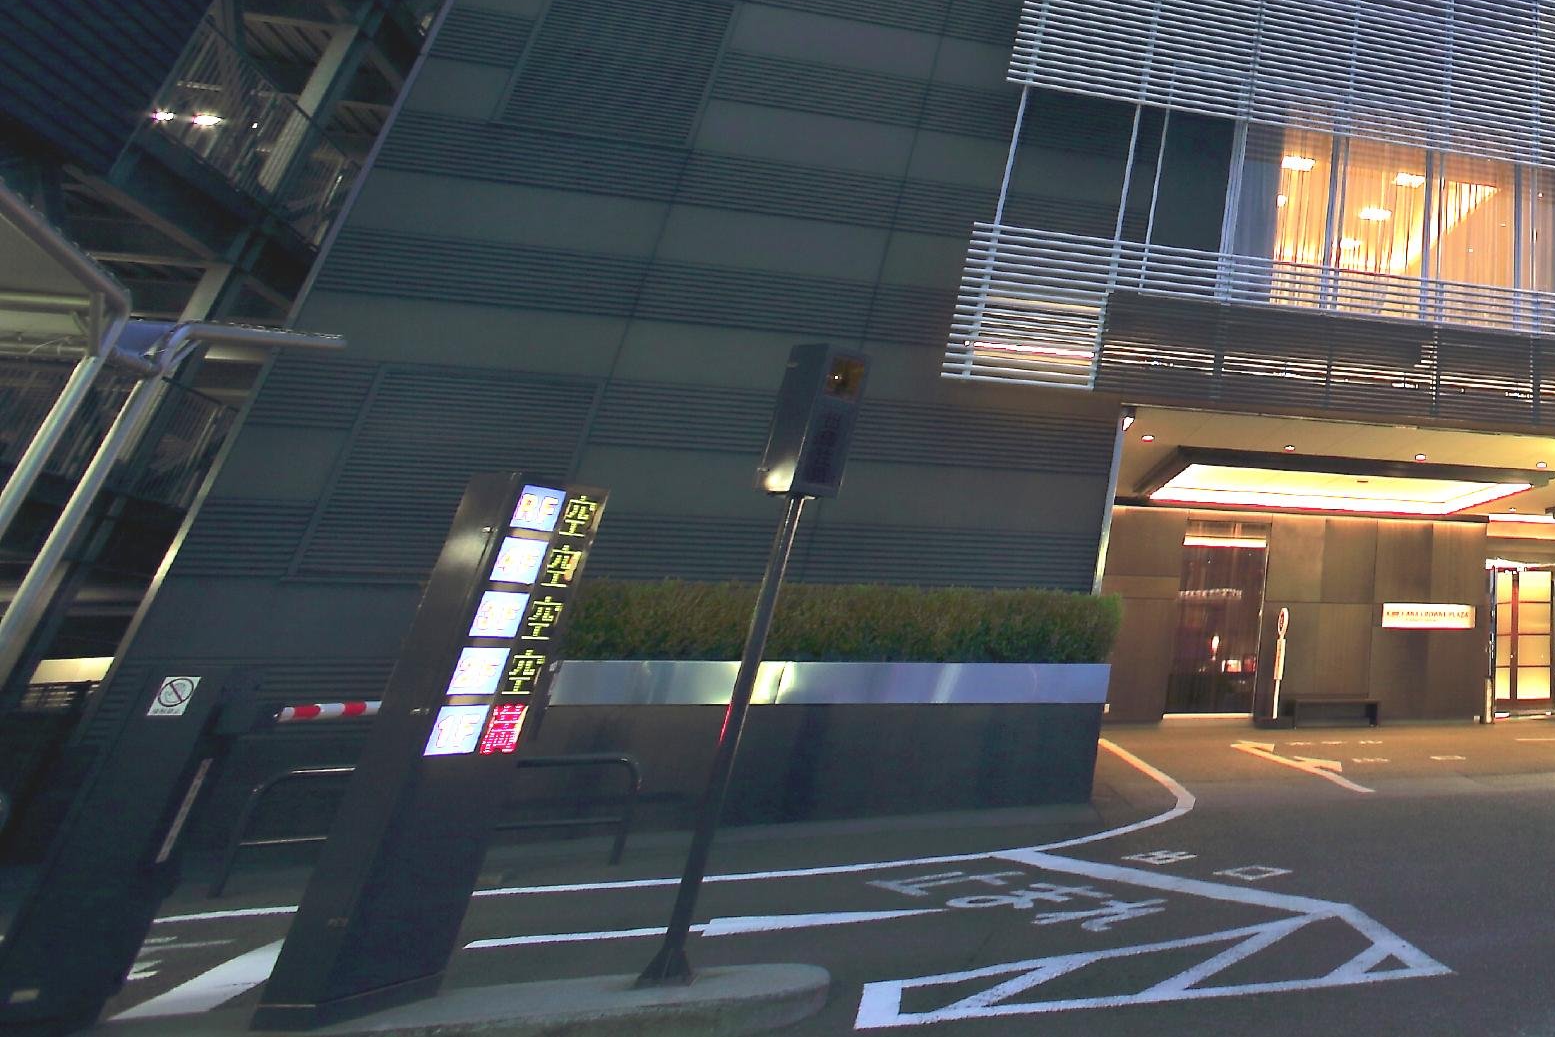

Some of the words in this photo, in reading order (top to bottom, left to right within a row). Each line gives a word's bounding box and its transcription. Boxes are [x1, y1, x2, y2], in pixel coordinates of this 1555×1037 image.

[514, 493, 559, 524] RF
[558, 495, 598, 537] 空
[540, 544, 583, 588] 空
[520, 595, 564, 640] 空
[501, 649, 546, 695] 空
[436, 713, 482, 749] 1F
[866, 871, 1168, 932] 止まれ
